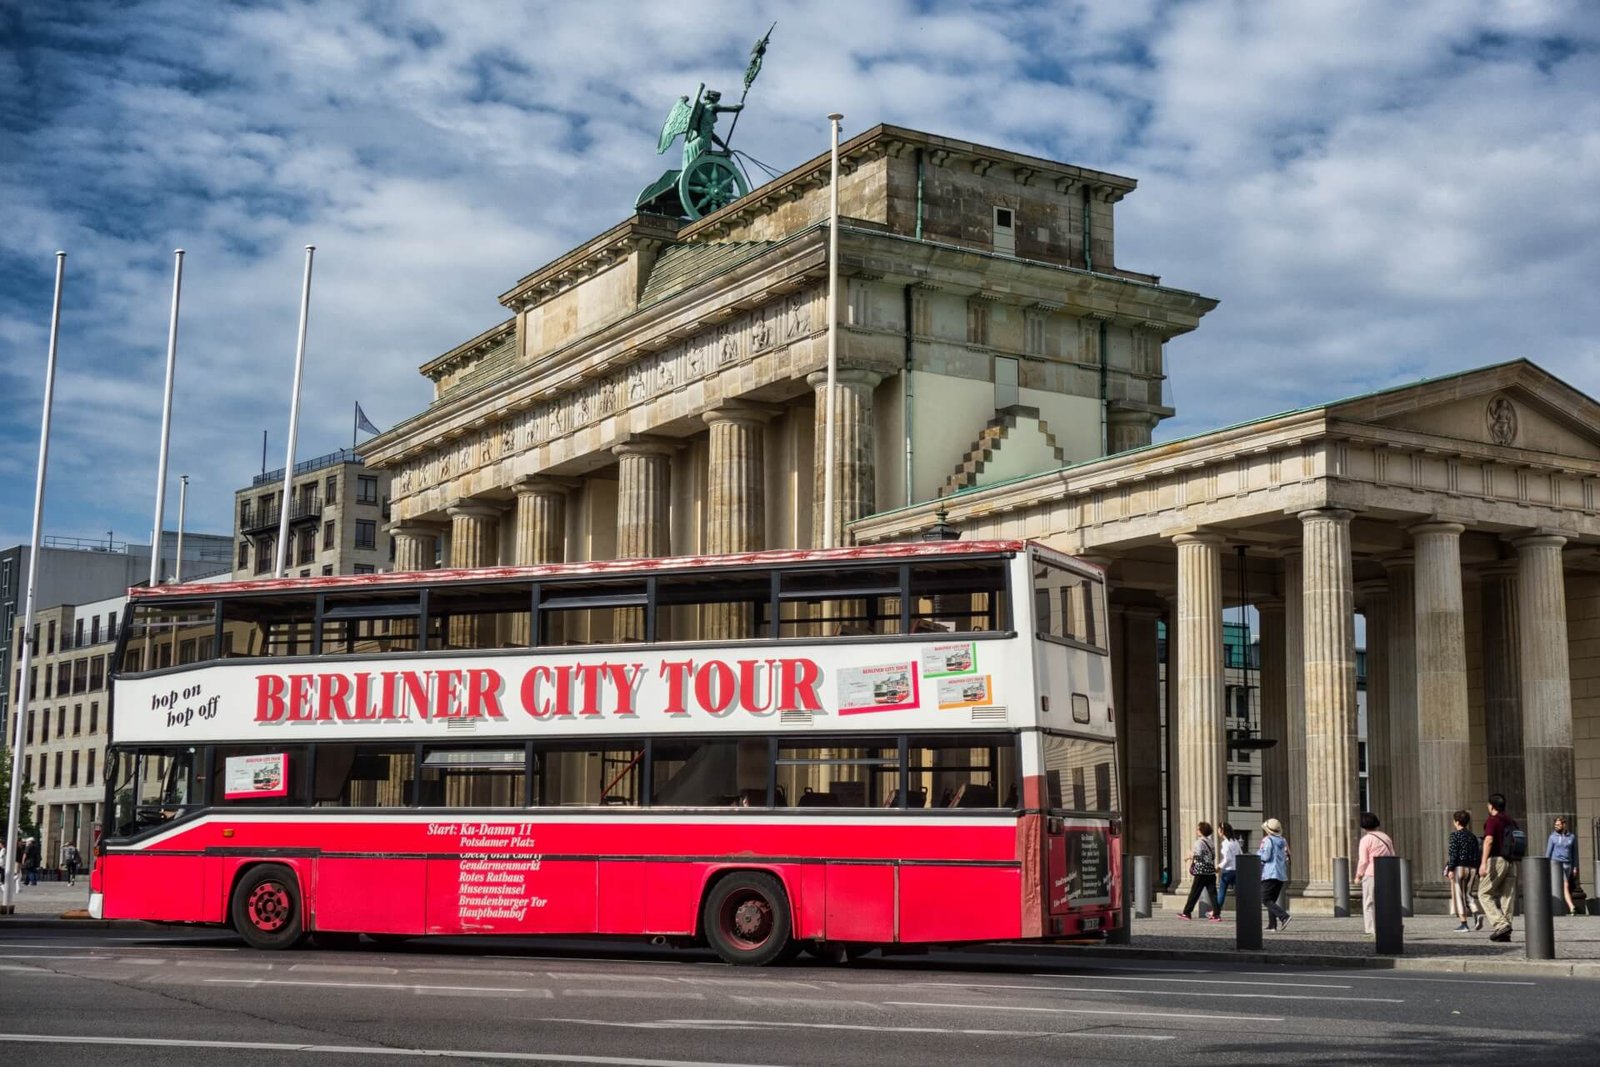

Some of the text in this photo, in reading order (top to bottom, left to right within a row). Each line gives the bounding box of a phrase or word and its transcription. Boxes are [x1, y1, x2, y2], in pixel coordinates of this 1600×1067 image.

[151, 684, 202, 711] hop on
[254, 657, 822, 725] BERLINER CITY TOUR
[167, 695, 220, 727] hop off
[427, 823, 532, 836] Start: Ku-Damm 11
[459, 837, 535, 848] Potsdamer Platz
[459, 860, 541, 871] Gendarmenmarkt
[459, 872, 525, 883] Rotes Rathaus
[459, 884, 525, 895] Museumsinsel
[459, 895, 547, 910] Brandenburger Tor
[459, 907, 527, 921] Hauptbahnhof
